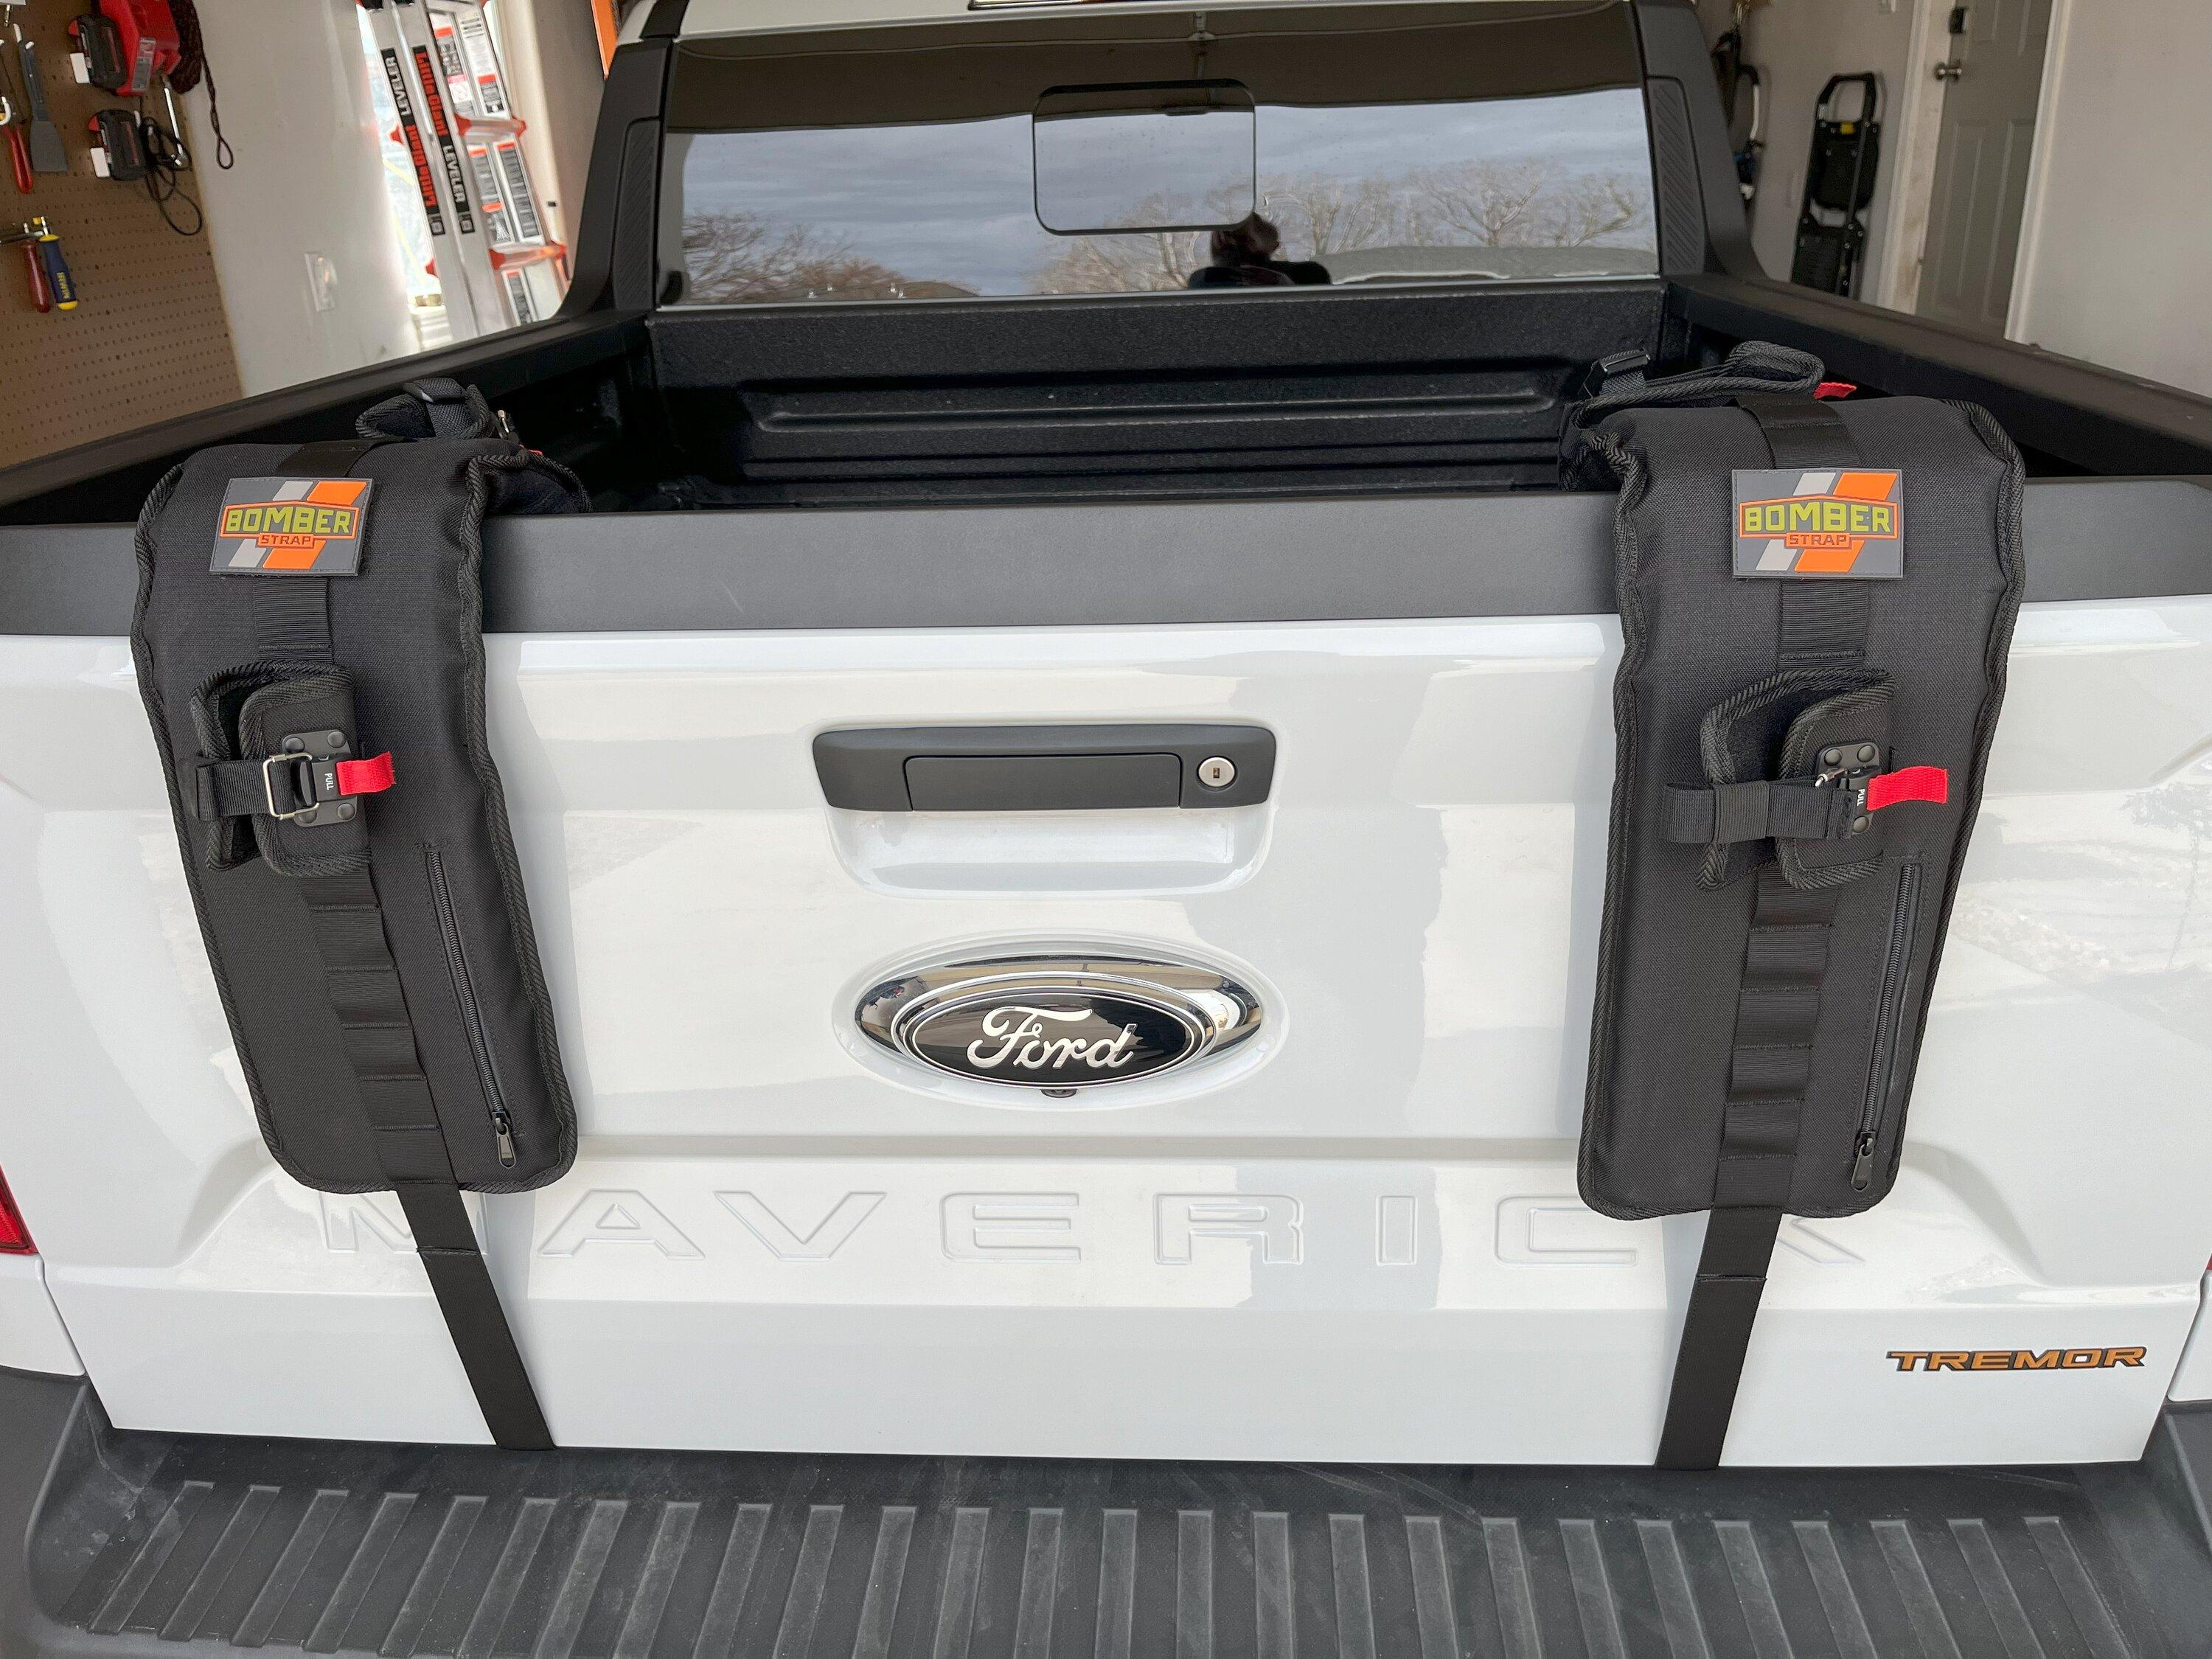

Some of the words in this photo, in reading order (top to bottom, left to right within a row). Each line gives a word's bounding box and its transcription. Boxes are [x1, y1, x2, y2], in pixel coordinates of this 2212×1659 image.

[385, 56, 411, 116] LEVELER
[414, 52, 439, 95] Little
[428, 94, 449, 136] Giant
[442, 145, 466, 203] LEVELER
[404, 125, 428, 166] Giant
[418, 165, 439, 206] Little
[225, 507, 352, 534] BOMBER
[1745, 501, 1891, 532] BOMBER
[261, 535, 313, 546] STRAP
[1789, 534, 1848, 546] STRAP
[324, 773, 334, 791] PULL
[1857, 788, 1866, 807] PULL
[966, 1006, 1136, 1069] Ford
[1885, 1346, 2148, 1372] TREMOR
